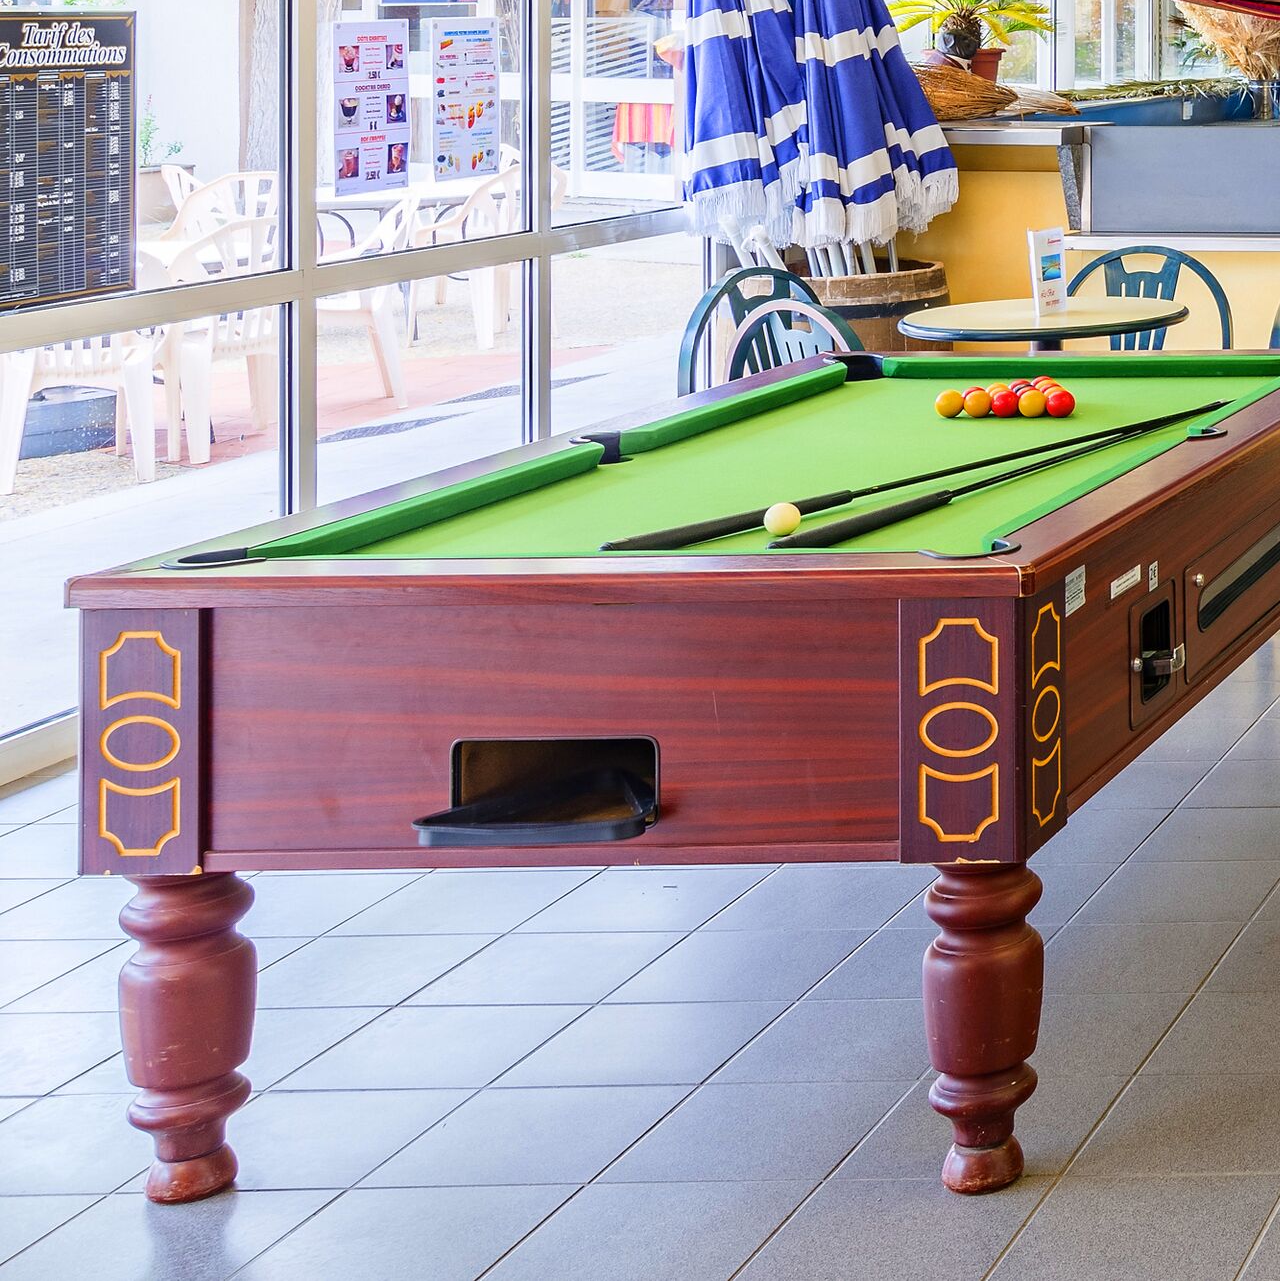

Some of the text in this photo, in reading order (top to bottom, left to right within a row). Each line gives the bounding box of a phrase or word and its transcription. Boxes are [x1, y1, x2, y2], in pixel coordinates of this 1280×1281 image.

[22, 21, 95, 48] Tarif des
[0, 41, 127, 67] Consommations
